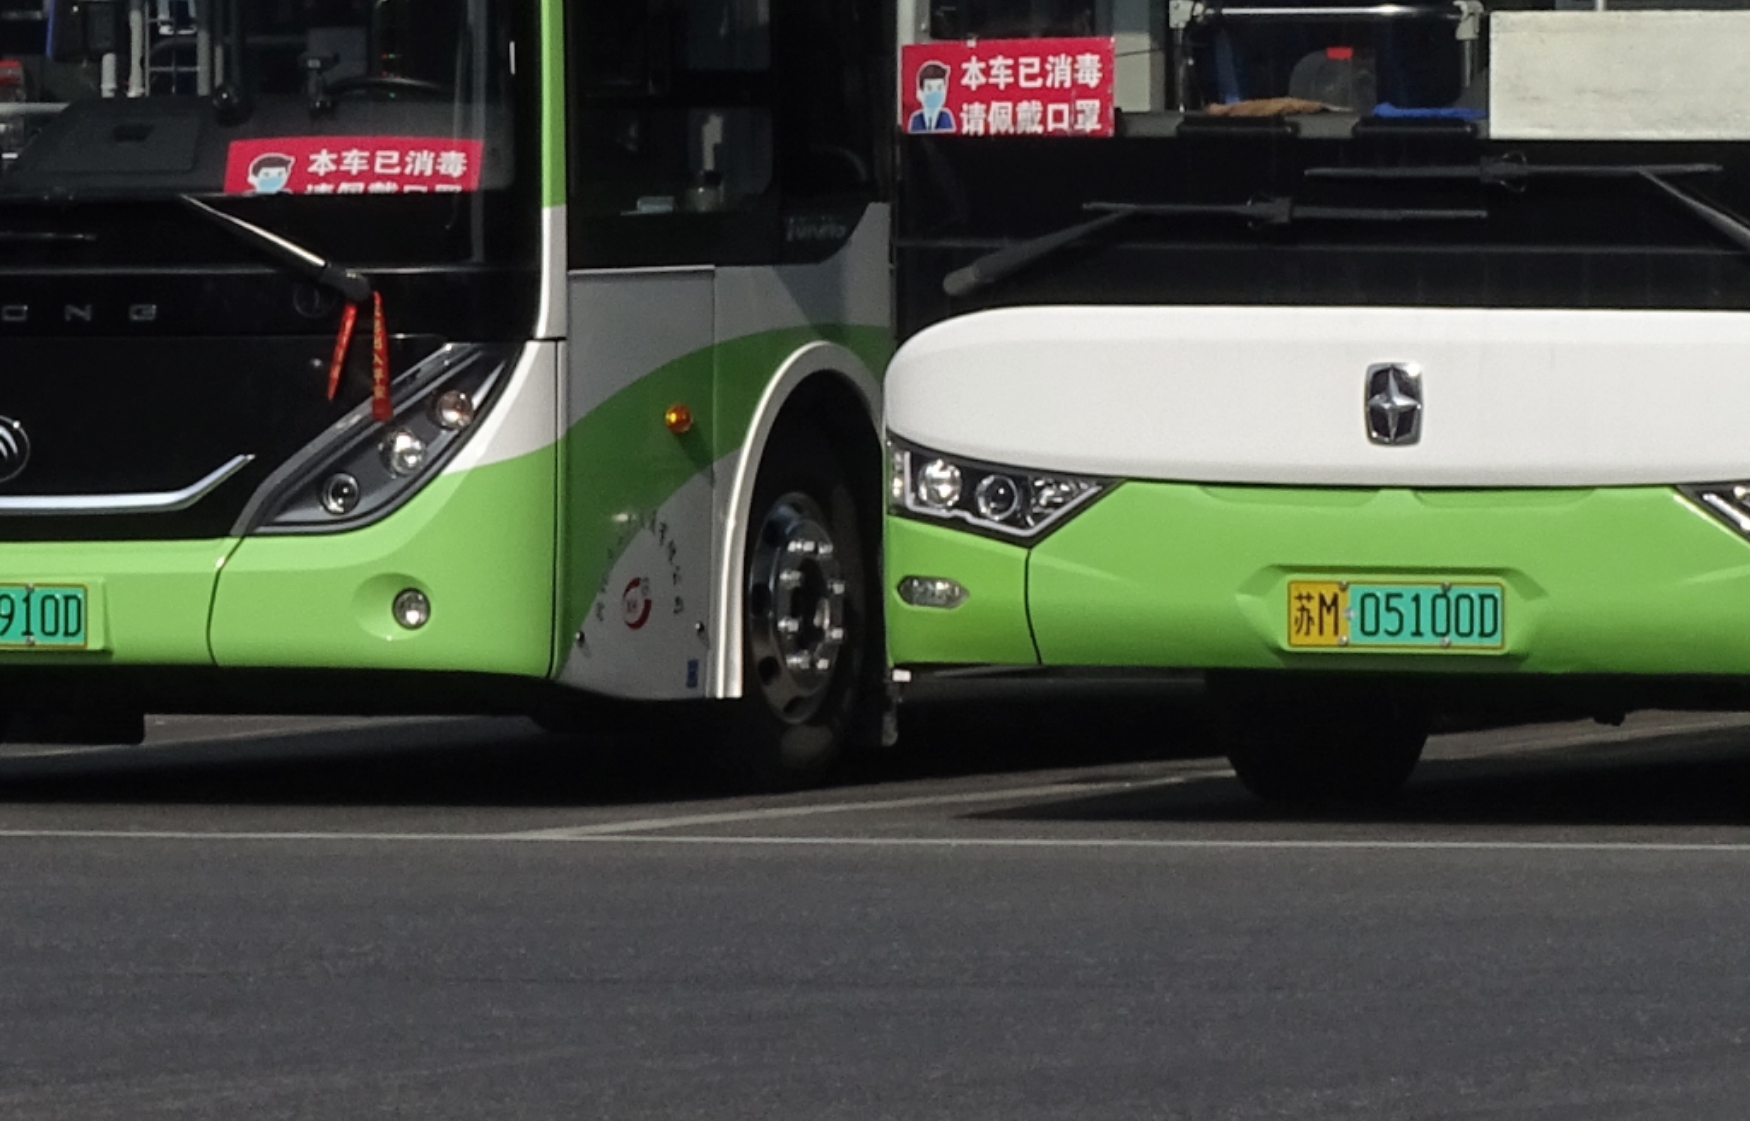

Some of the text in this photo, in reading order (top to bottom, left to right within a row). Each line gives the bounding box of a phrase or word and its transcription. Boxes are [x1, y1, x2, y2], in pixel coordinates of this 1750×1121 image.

[960, 53, 1102, 90] 本车已消毒
[960, 99, 1102, 135] 请佩戴口罩
[307, 149, 468, 177] 本车已消毒
